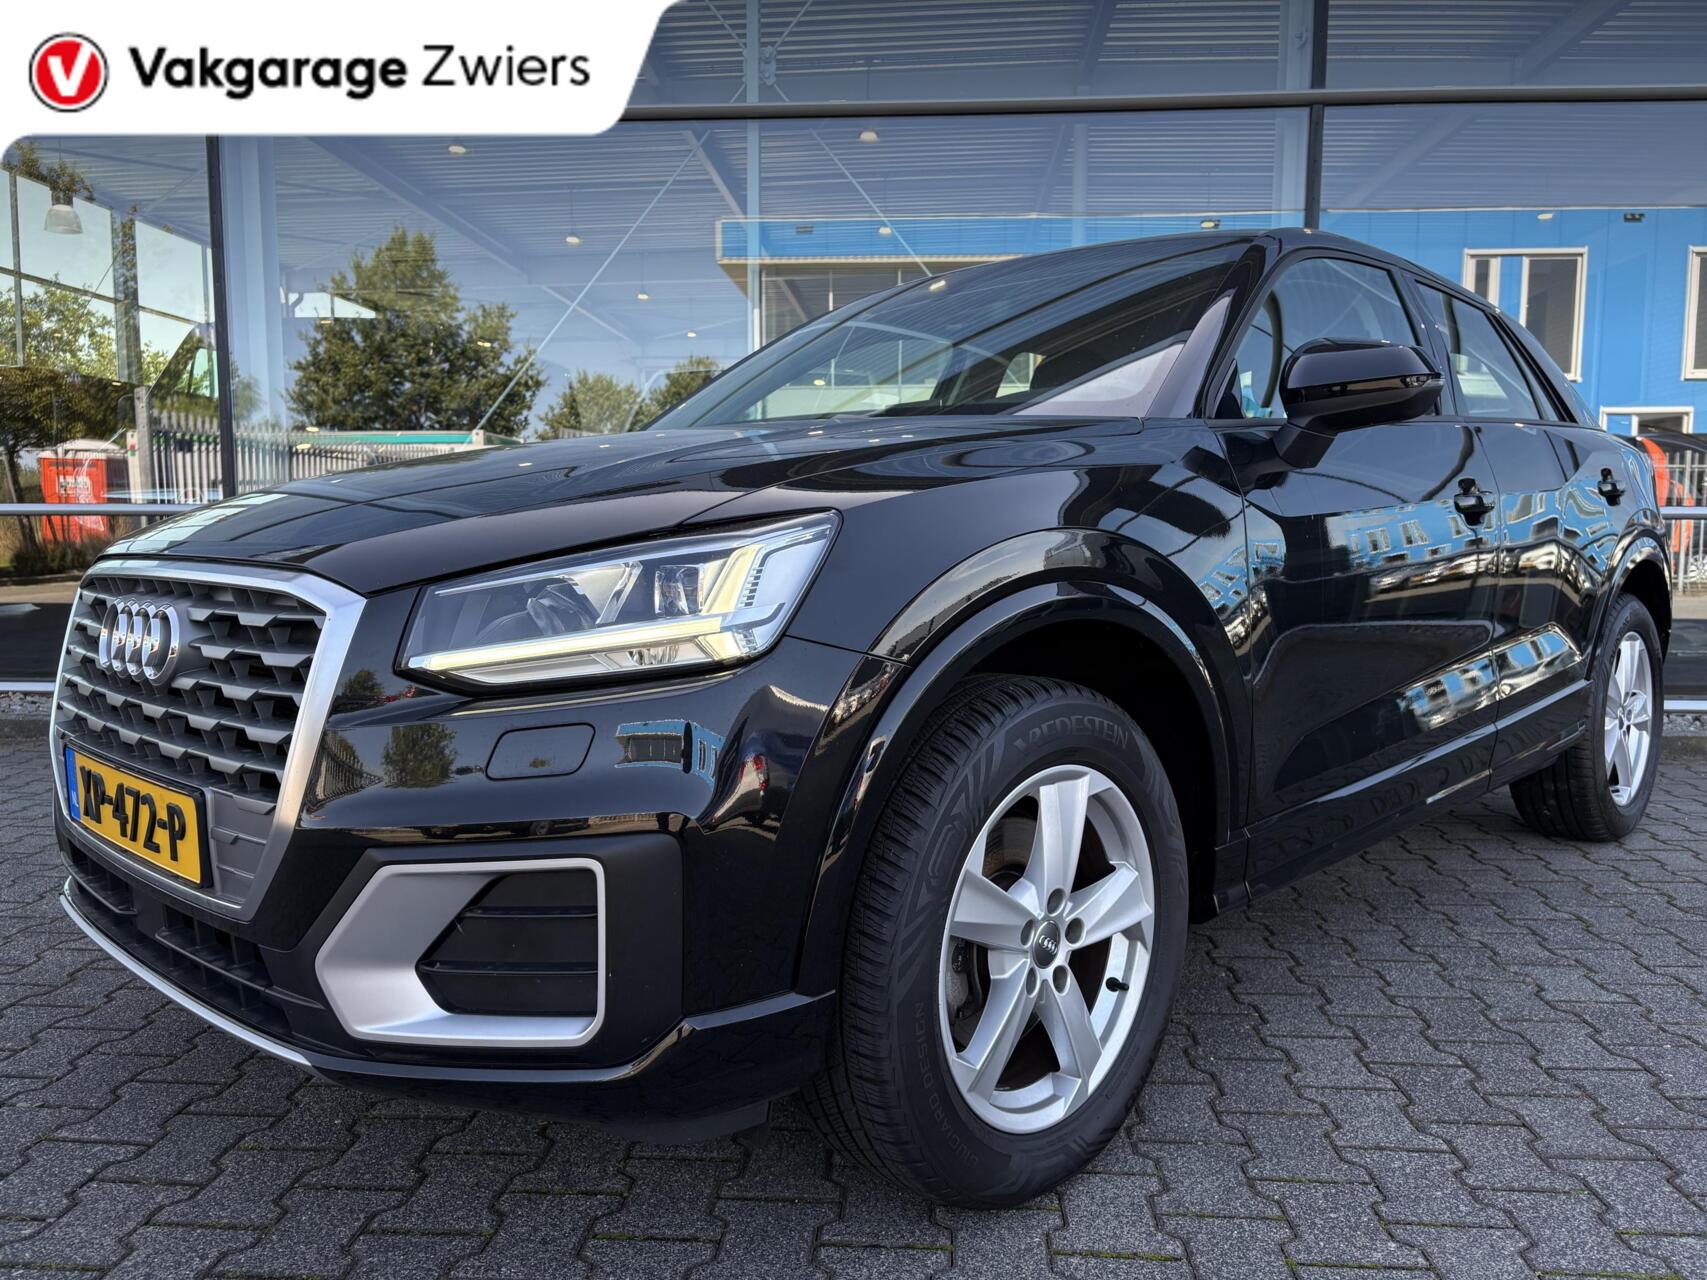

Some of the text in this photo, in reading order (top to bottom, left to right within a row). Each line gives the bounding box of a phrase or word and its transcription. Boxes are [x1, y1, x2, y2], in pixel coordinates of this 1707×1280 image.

[1013, 715, 1128, 750] VREDESTEIN
[80, 765, 186, 862] XP-472-P
[914, 1002, 933, 1089] DESIGN
